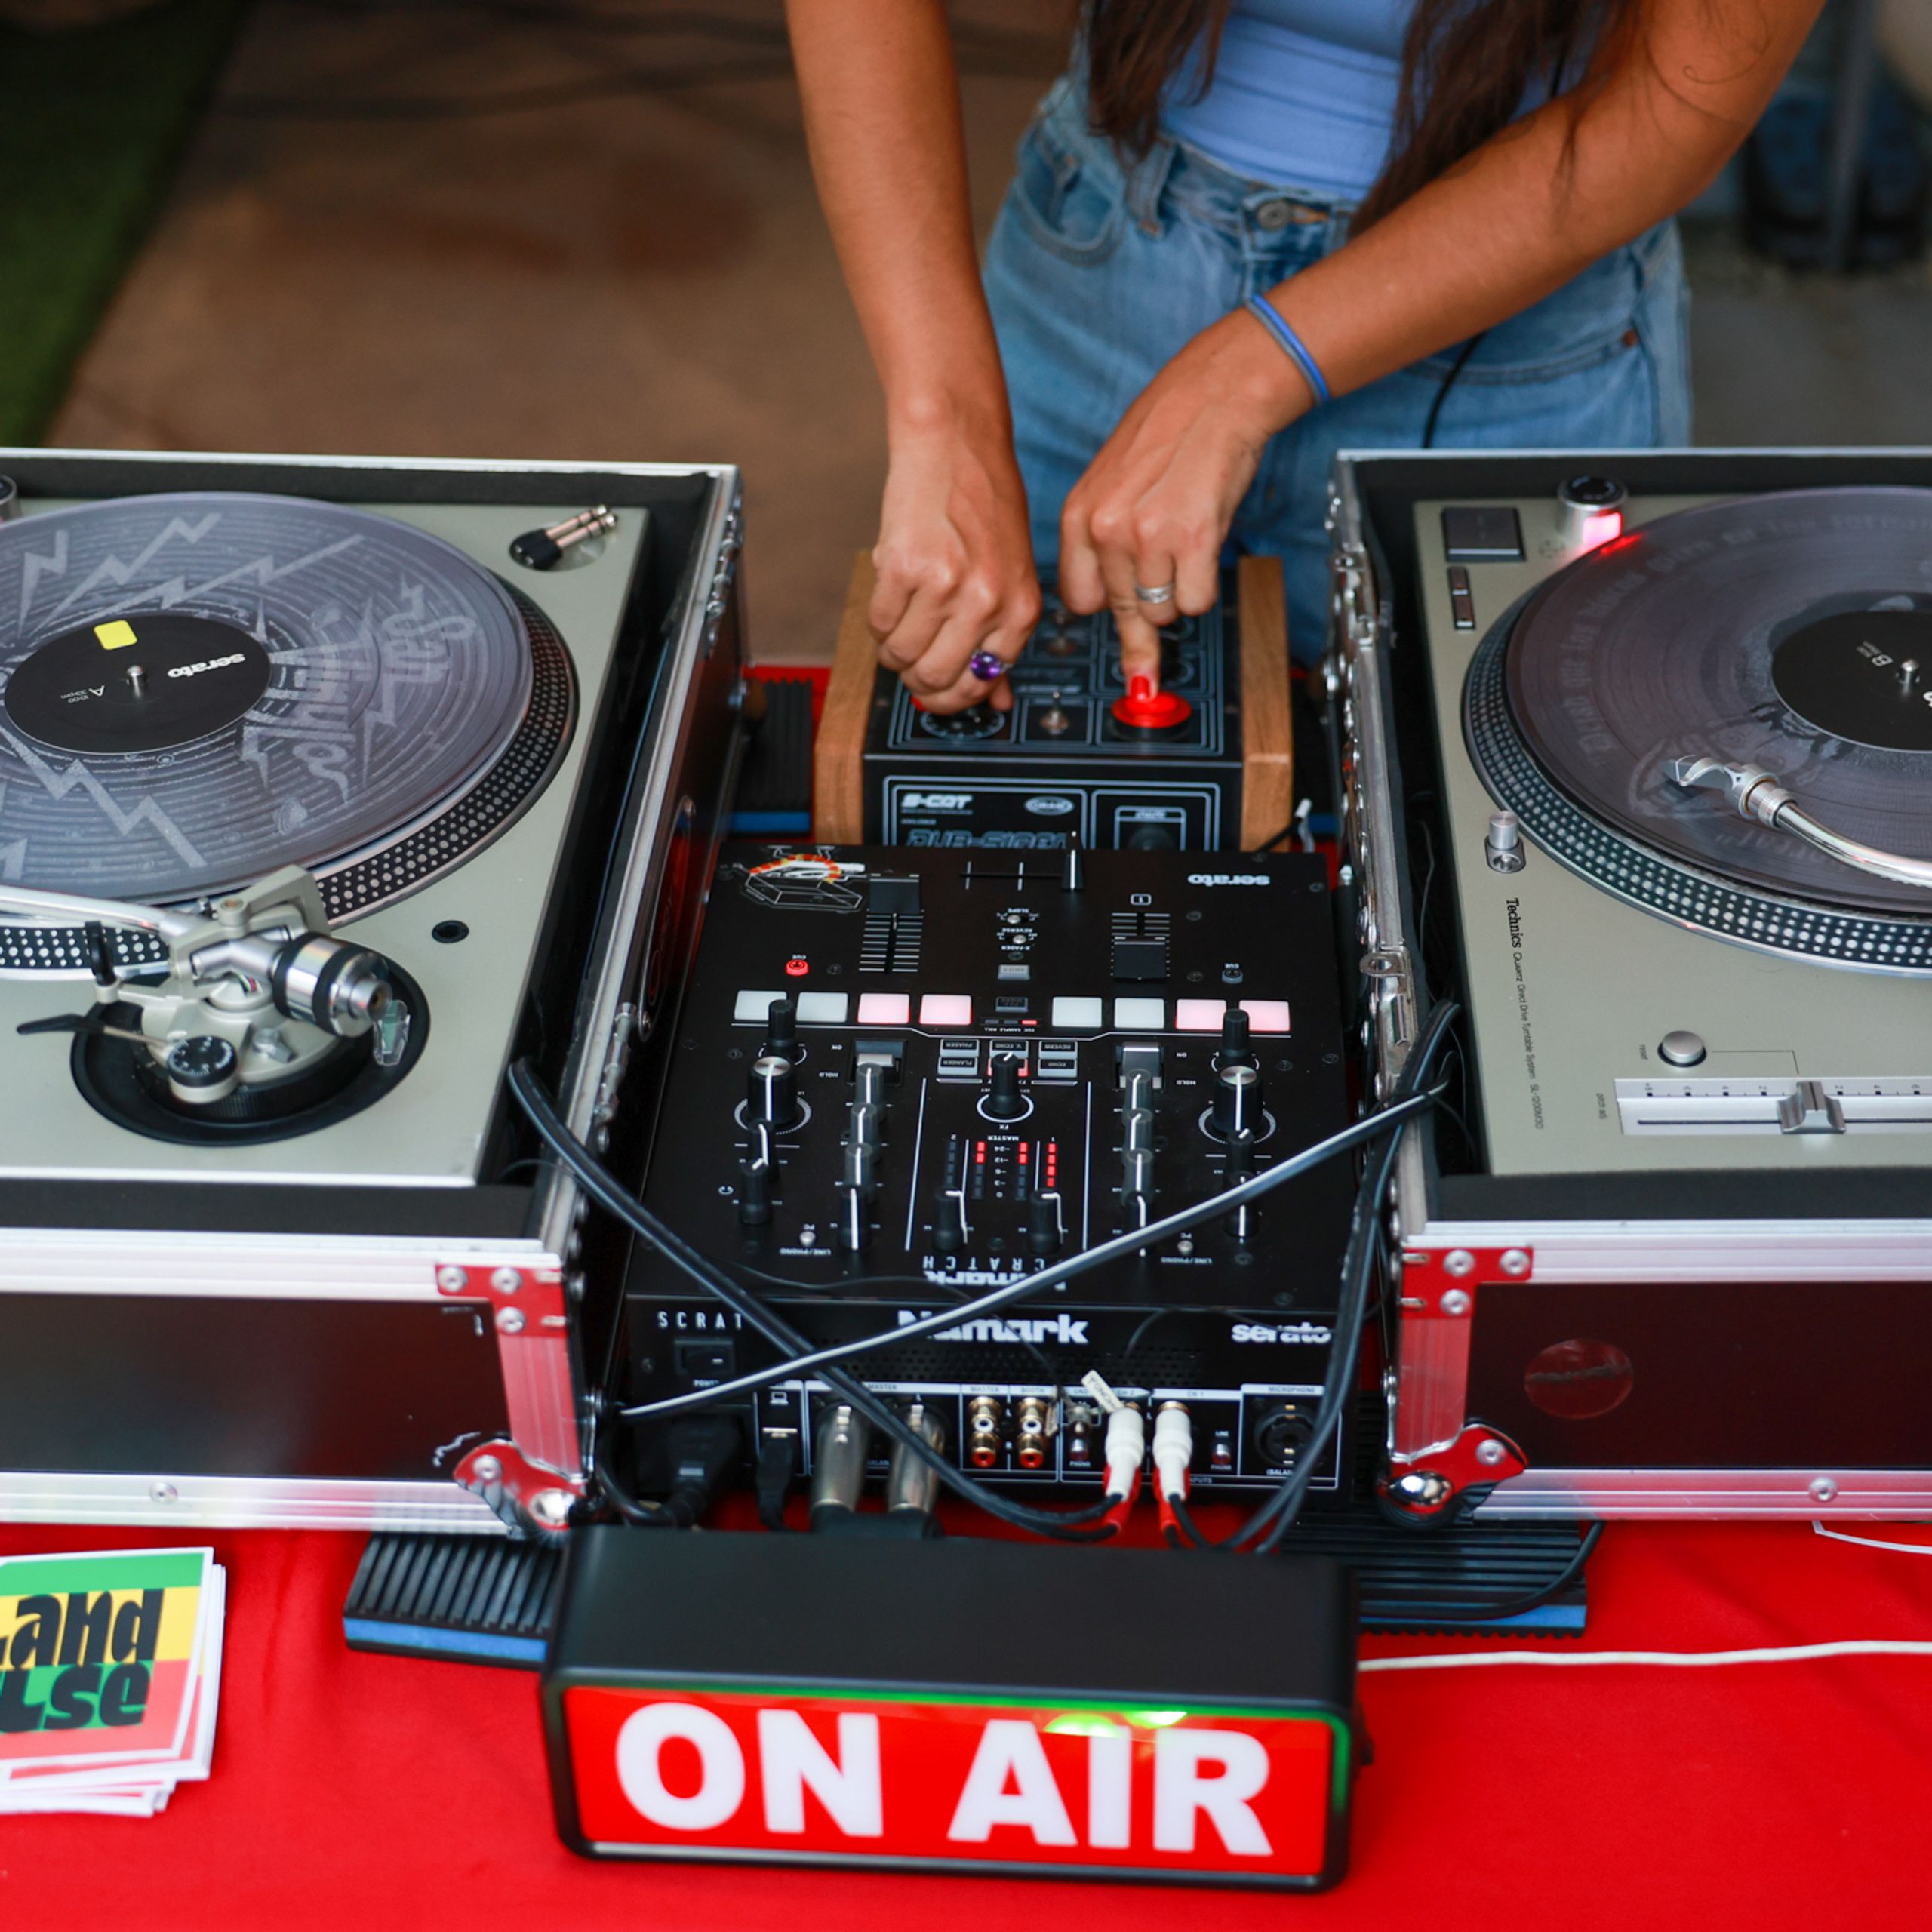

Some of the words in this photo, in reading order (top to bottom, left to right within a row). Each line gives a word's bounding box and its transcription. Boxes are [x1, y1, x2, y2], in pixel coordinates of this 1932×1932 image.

[167, 654, 245, 678] serato
[1872, 654, 1893, 666] B
[89, 685, 106, 697] A
[1187, 874, 1271, 887] serato
[1506, 897, 1524, 948] Technics
[922, 1255, 1062, 1271] CRATCH
[657, 1311, 743, 1330] SCRAT
[1231, 1321, 1332, 1344] serato
[615, 1703, 883, 1837] ON
[947, 1718, 1273, 1857] AIR
